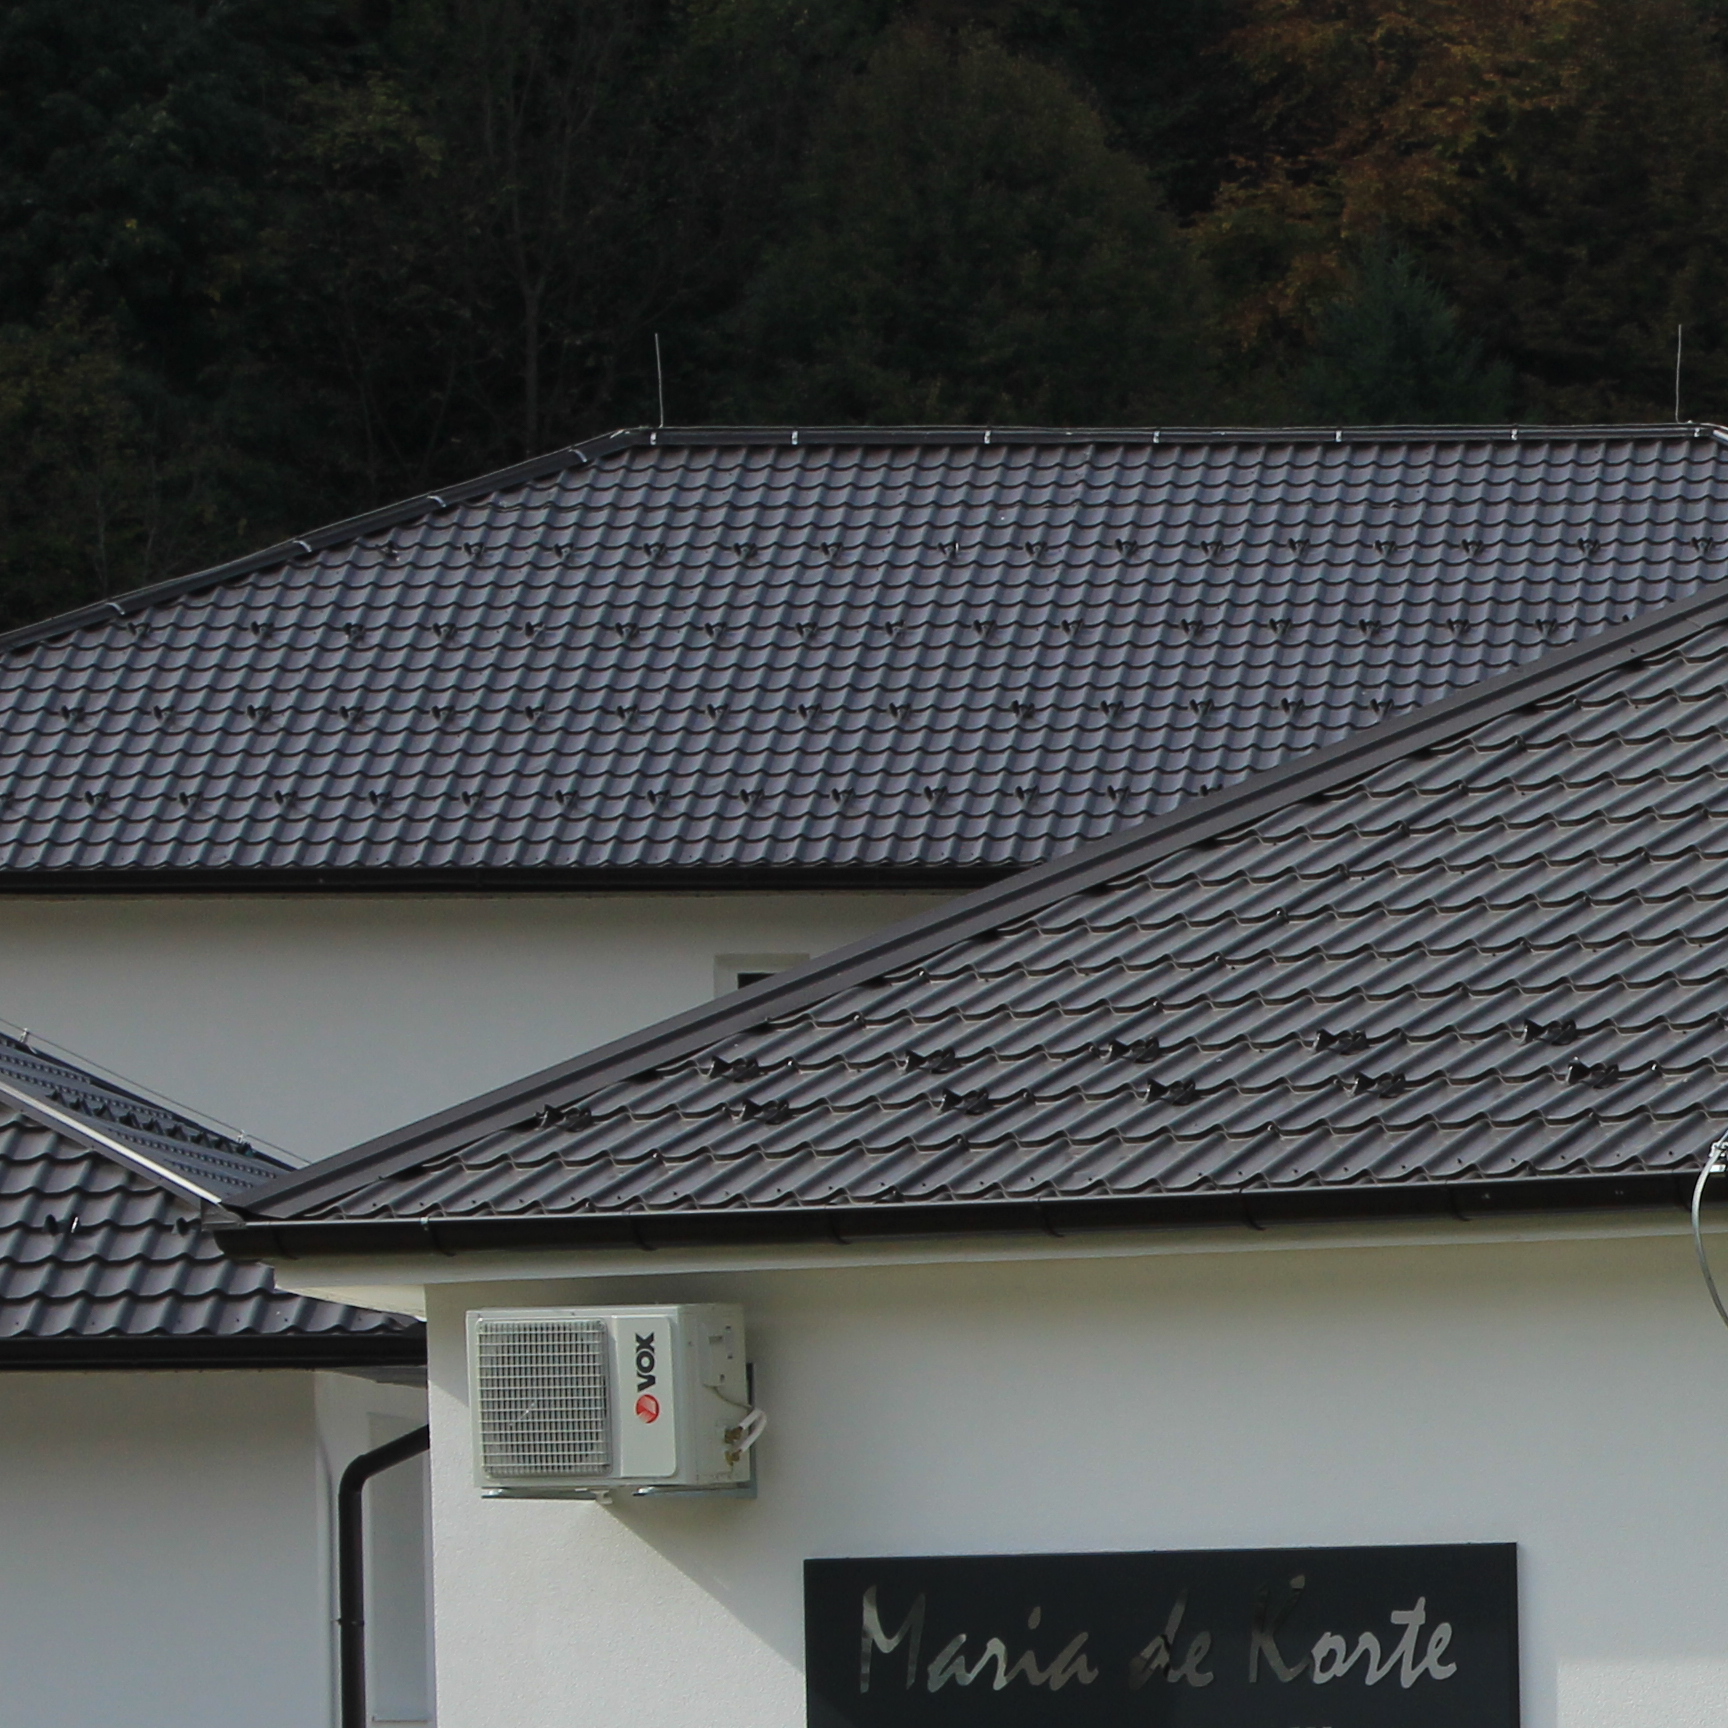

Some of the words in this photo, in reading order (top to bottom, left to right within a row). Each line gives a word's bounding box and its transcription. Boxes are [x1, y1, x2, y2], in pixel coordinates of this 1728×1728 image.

[635, 1332, 656, 1392] VOX
[859, 1584, 1099, 1693] Maria
[1128, 1589, 1214, 1692] de
[1249, 1574, 1457, 1689] Korte
